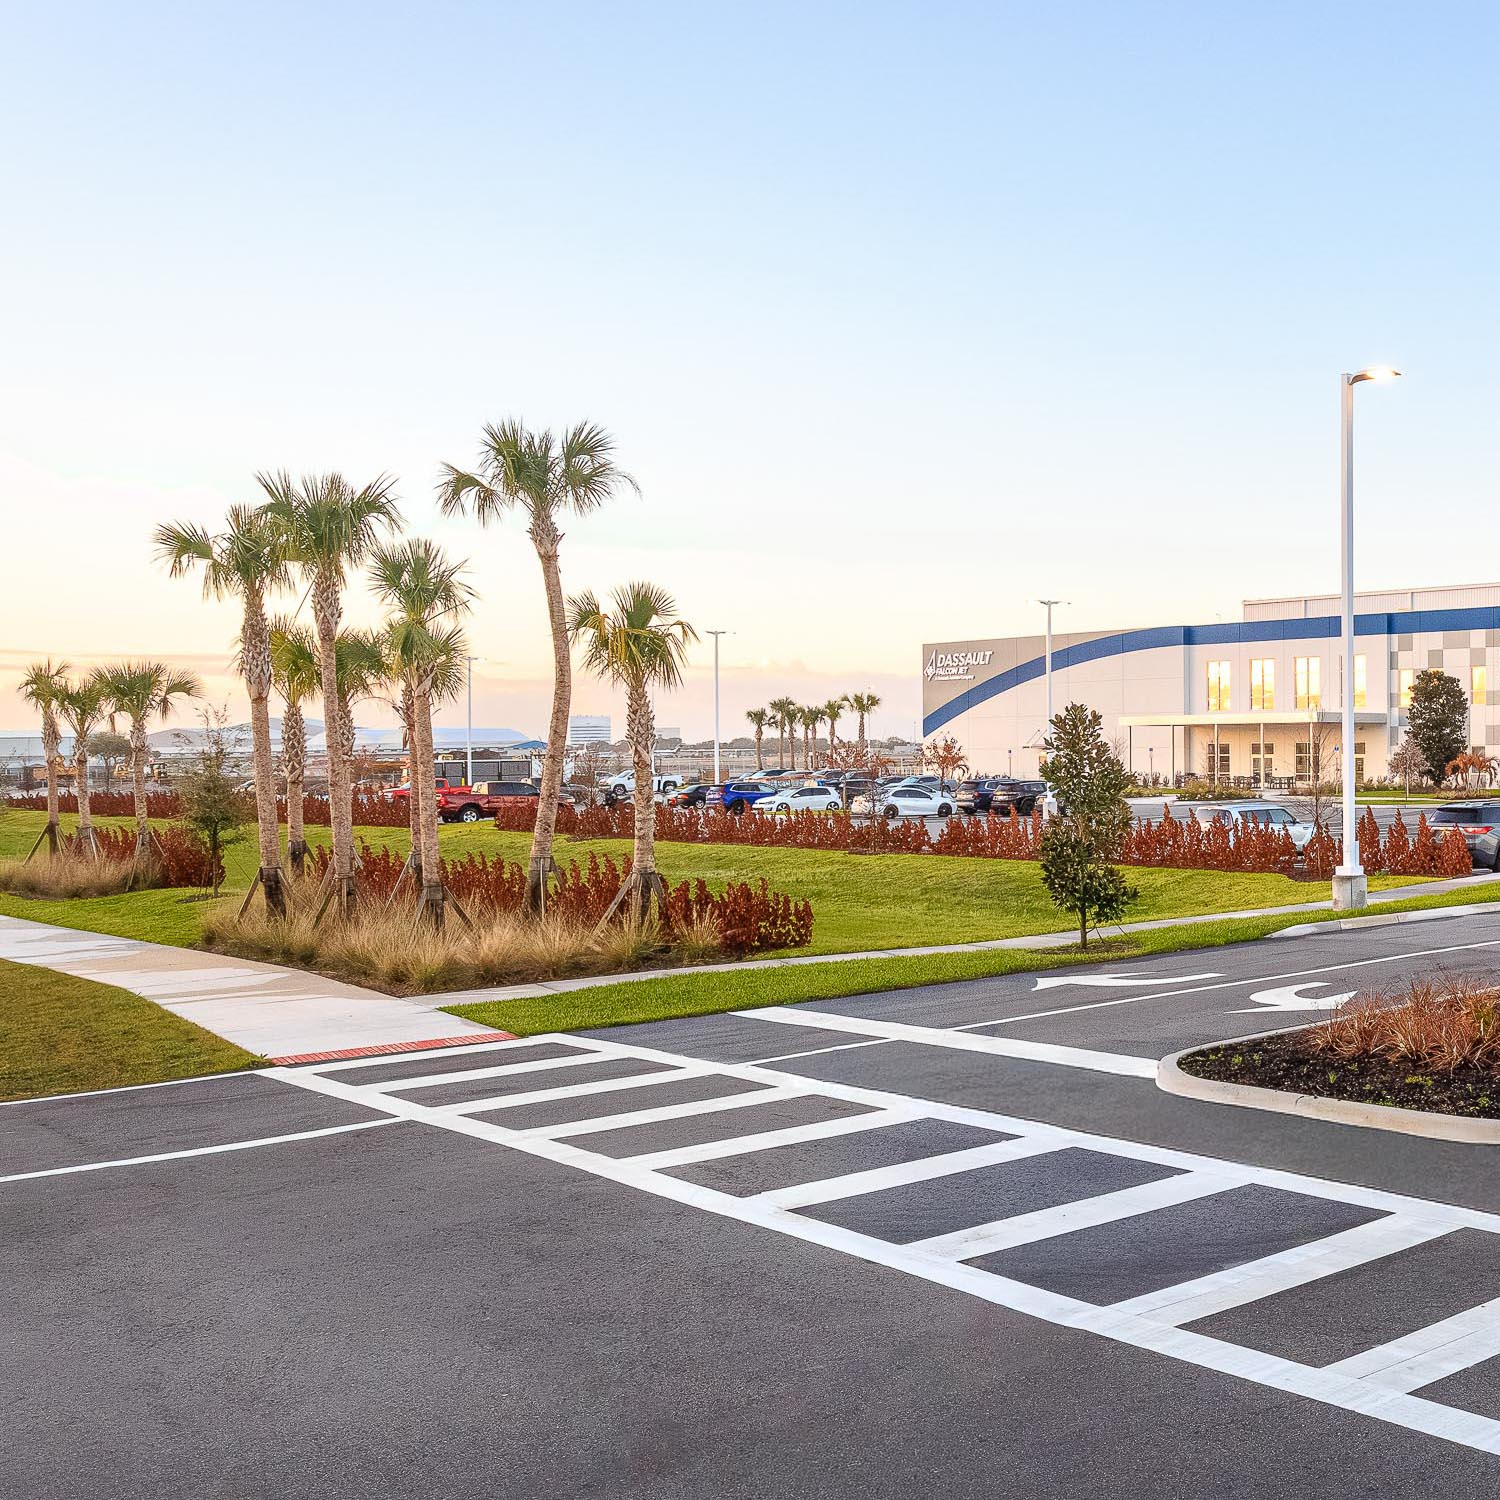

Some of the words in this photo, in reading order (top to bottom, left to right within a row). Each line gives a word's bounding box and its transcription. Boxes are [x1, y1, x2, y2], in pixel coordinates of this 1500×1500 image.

[937, 651, 994, 667] DASSAULT
[936, 667, 959, 676] FALCON
[959, 666, 969, 674] JET
